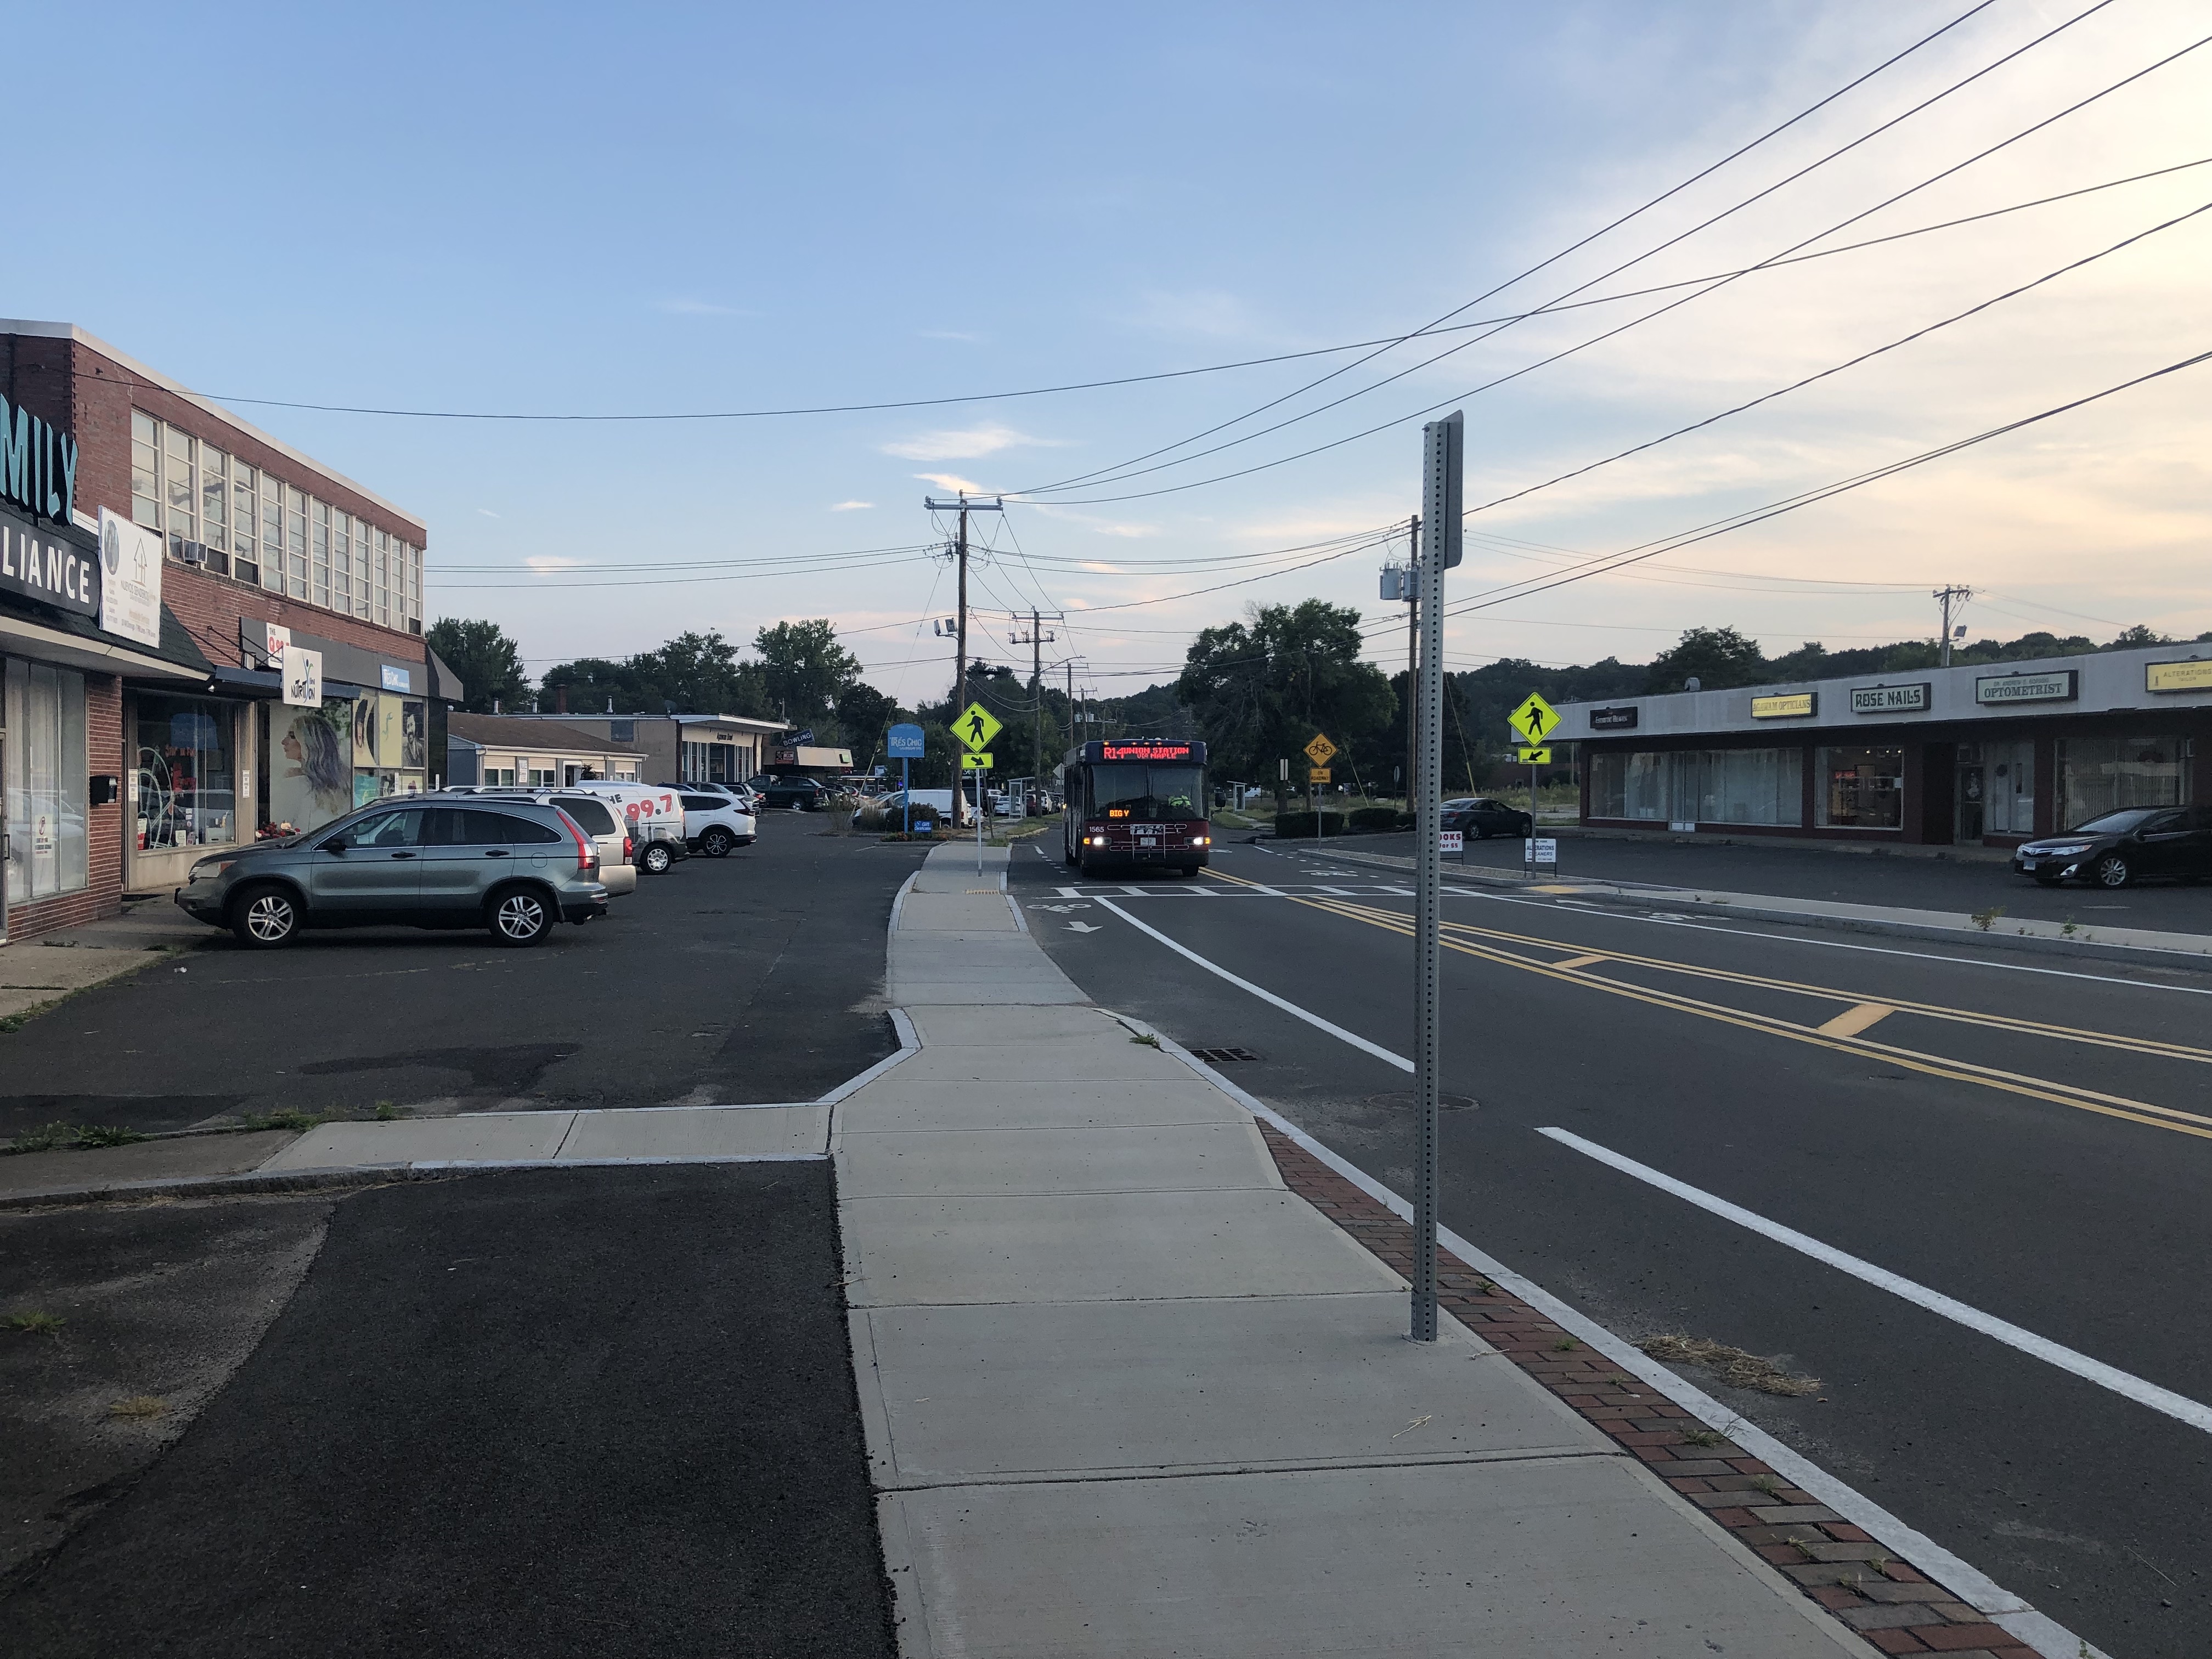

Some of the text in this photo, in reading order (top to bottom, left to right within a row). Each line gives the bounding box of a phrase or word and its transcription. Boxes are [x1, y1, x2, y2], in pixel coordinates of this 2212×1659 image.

[0, 393, 78, 526] MILY
[2, 526, 90, 604] LIANCE
[269, 636, 275, 652] Q
[2163, 669, 2212, 678] ALTERATIONS
[1984, 683, 2062, 698] OPTOMETRIST
[1752, 699, 1811, 712] AGAWAM OPTICIANS
[1855, 689, 1921, 708] ROSE NAILS
[783, 732, 811, 746] BOWLING
[907, 737, 922, 747] CHIC
[1104, 747, 1125, 759] R14
[626, 794, 672, 821] 99.7
